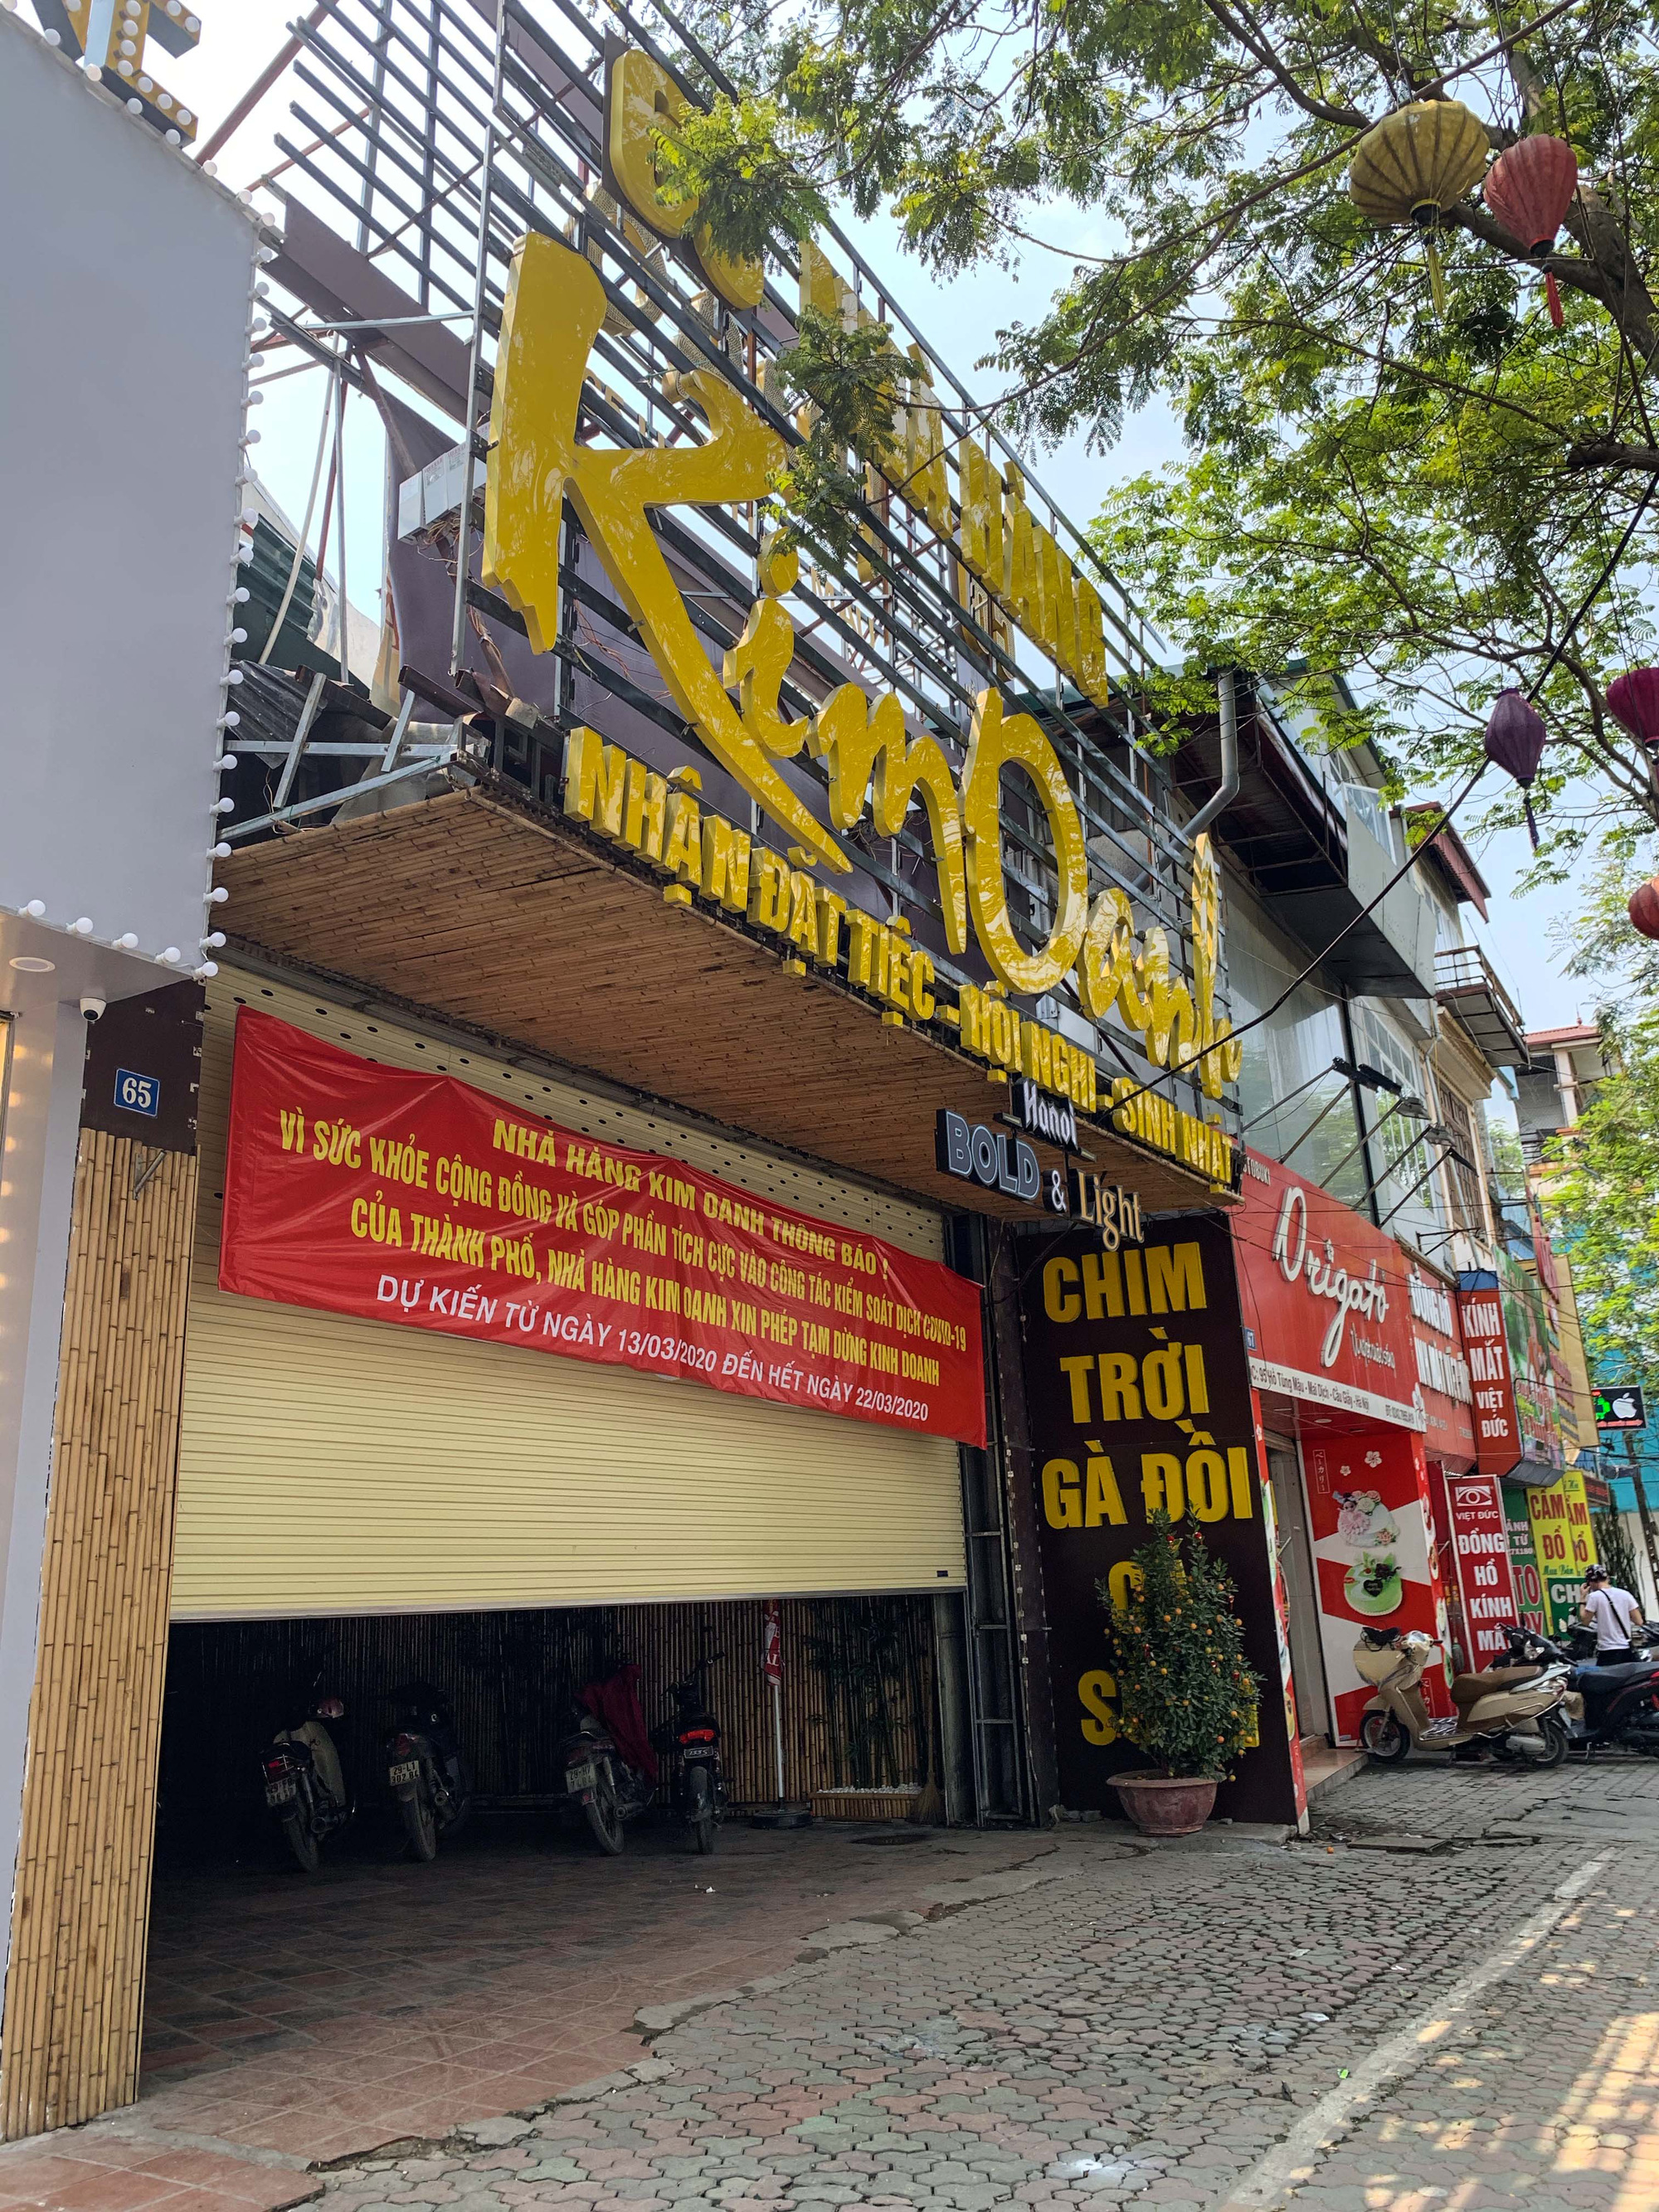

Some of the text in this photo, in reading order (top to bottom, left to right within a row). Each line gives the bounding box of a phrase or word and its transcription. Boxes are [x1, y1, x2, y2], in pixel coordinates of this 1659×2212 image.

[564, 726, 752, 913] NHẬN
[747, 846, 847, 978] ĐẶT
[844, 908, 936, 1028] TIỆC
[959, 980, 1022, 1083] HỘI
[1112, 1077, 1177, 1156] SINH
[1175, 1111, 1233, 1194] NHẬT
[122, 1077, 153, 1109] 65
[1023, 1080, 1078, 1151] Hanoi
[493, 1118, 557, 1168] NHÀ
[565, 1143, 643, 1194] HÀNG
[648, 1170, 697, 1212] KIM
[703, 1191, 766, 1237] OANH
[770, 1215, 836, 1262] THÔNG
[840, 1242, 878, 1276] BÁO
[945, 1108, 1146, 1252] BOLD & Light
[279, 1106, 967, 1352] VÌ SỨC KHỎE CỘNG ĐỒNG VÀ GÓP PHẦN TÍCH CỰC VÀO CÔNG TÁC KIỂM SOÁT DỊCH COVID-19
[351, 1189, 941, 1388] CỦA THÀNH PHỐ, NHÀ HÀNG KIM OANH XIN PHÉP TẠM DỪNG KINH DOANH
[1042, 1241, 1208, 1325] CHIM
[1462, 1296, 1501, 1338] KÍNH
[377, 1273, 929, 1422] DỰ KIẾN TỪ NGÀY 13/03/2020 ĐẾN HẾT NGÀY 22/03/2020
[1058, 1326, 1211, 1424] TRỜI
[1469, 1338, 1505, 1382] MẮT
[1476, 1387, 1504, 1412] VIỆT
[1481, 1414, 1509, 1439] ĐỨC
[1041, 1418, 1254, 1530] GÀ ĐỒI
[1456, 1509, 1499, 1522] VIỆT ĐỨC
[1457, 1527, 1506, 1555] ĐỒNG
[1473, 1558, 1499, 1587] HỒ
[1469, 1592, 1514, 1618] KÍNH
[1477, 1621, 1511, 1650] MẮ
